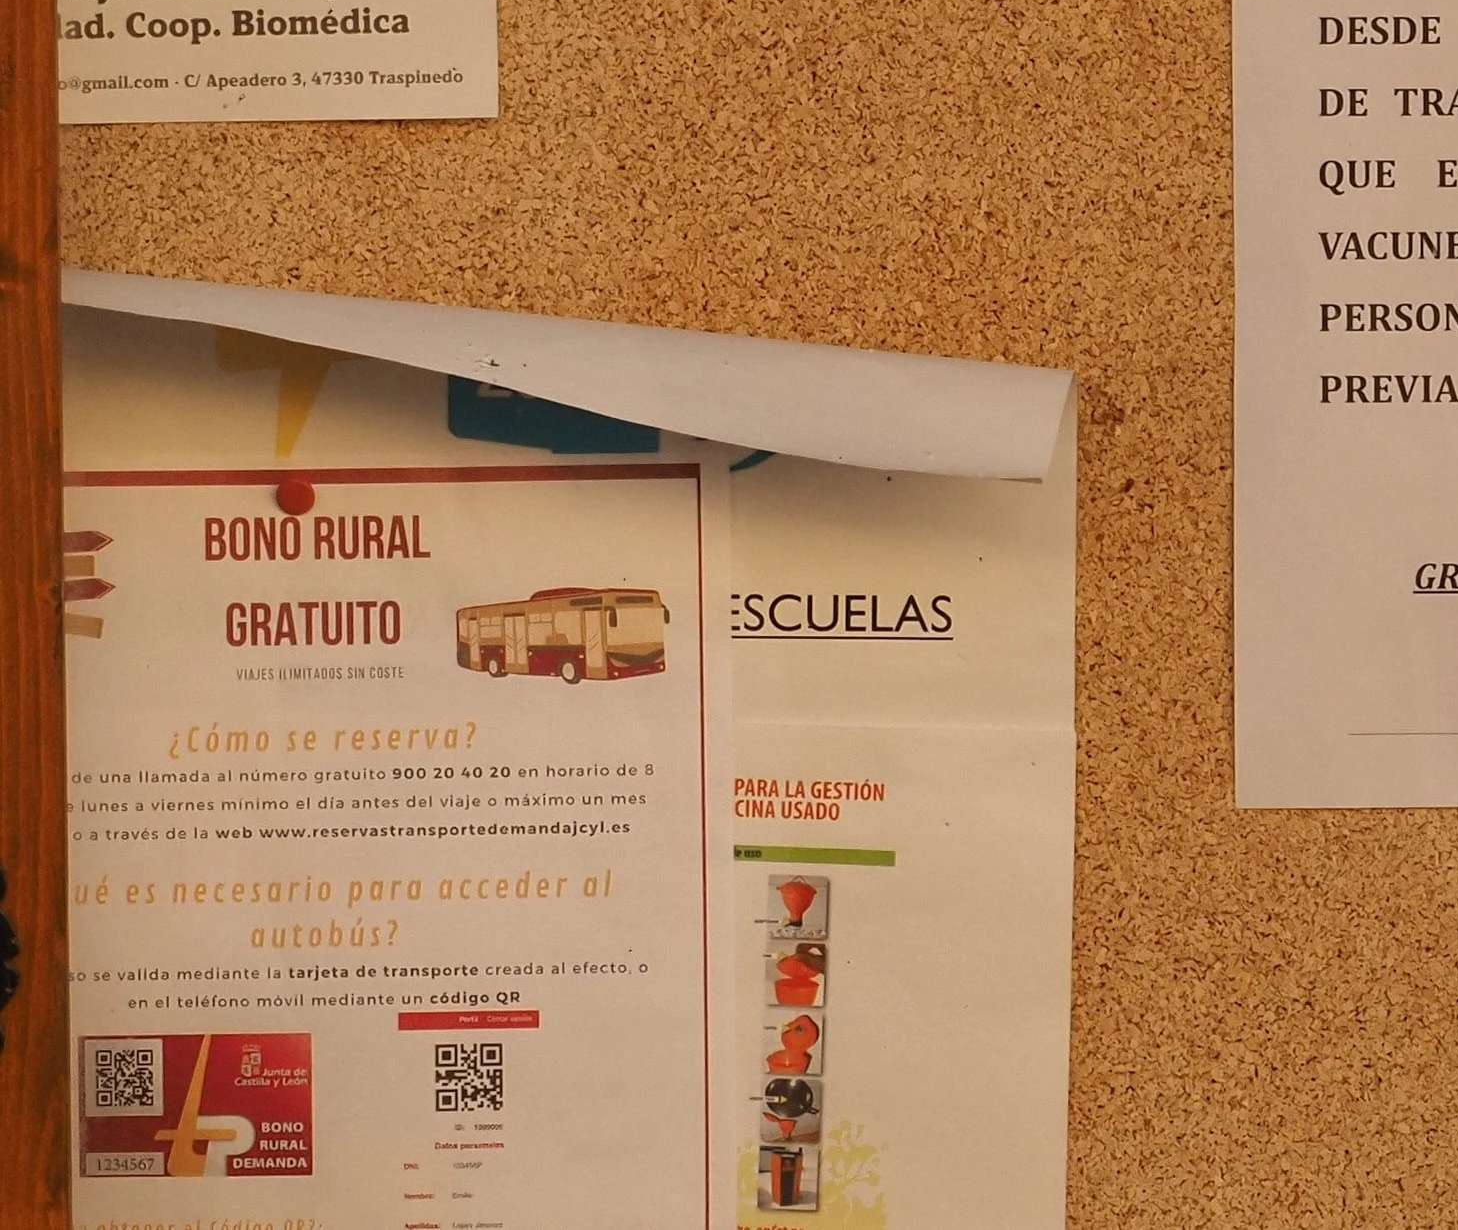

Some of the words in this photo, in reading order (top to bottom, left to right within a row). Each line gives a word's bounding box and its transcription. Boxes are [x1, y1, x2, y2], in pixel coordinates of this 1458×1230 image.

[1319, 17, 1440, 44] DESDE
[205, 516, 302, 561] BONO
[313, 515, 432, 560] RURAL
[226, 601, 400, 646] GRATUITO
[735, 779, 779, 802] PARA
[786, 781, 805, 798] LA
[811, 779, 884, 801] GESTIÓN
[128, 1000, 147, 1008] en
[155, 996, 169, 1008] el
[178, 995, 249, 1008] teléfono
[257, 994, 303, 1006] móvil
[312, 994, 394, 1006] mediante
[402, 996, 422, 1004] un
[430, 991, 489, 1006] código
[496, 992, 520, 1005] QR
[260, 1121, 304, 1133] BONO
[259, 1139, 308, 1151] RURAL
[95, 1157, 156, 1172] 1234567
[232, 1157, 308, 1170] DEMANDA
